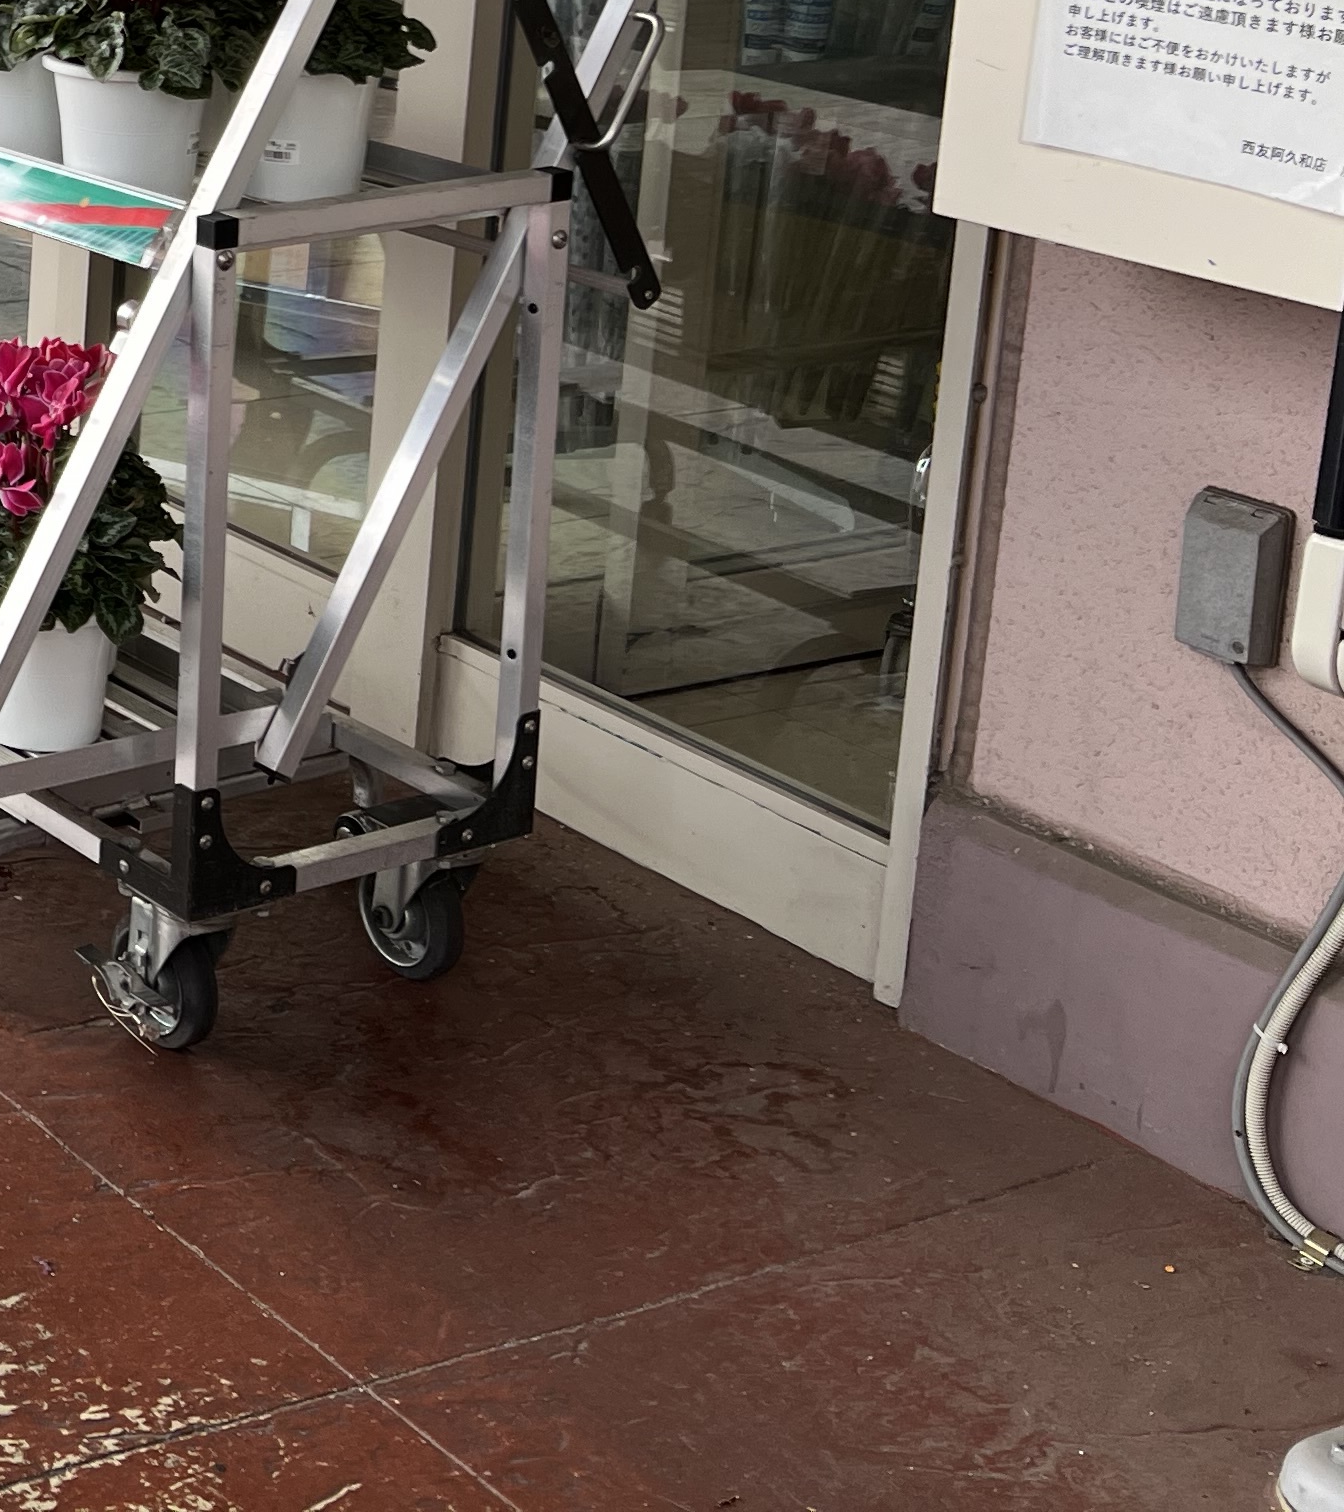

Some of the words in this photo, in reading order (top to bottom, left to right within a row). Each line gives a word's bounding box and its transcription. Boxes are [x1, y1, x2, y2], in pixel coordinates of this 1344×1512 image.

[1068, 4, 1160, 33] 申し上げます。
[1063, 44, 1318, 105] ご理解頂きます様お願い申し上げます。
[1065, 24, 1332, 85] お客様にはご不便をおかけいたしますが
[1240, 139, 1329, 173] 西友阿久和店
